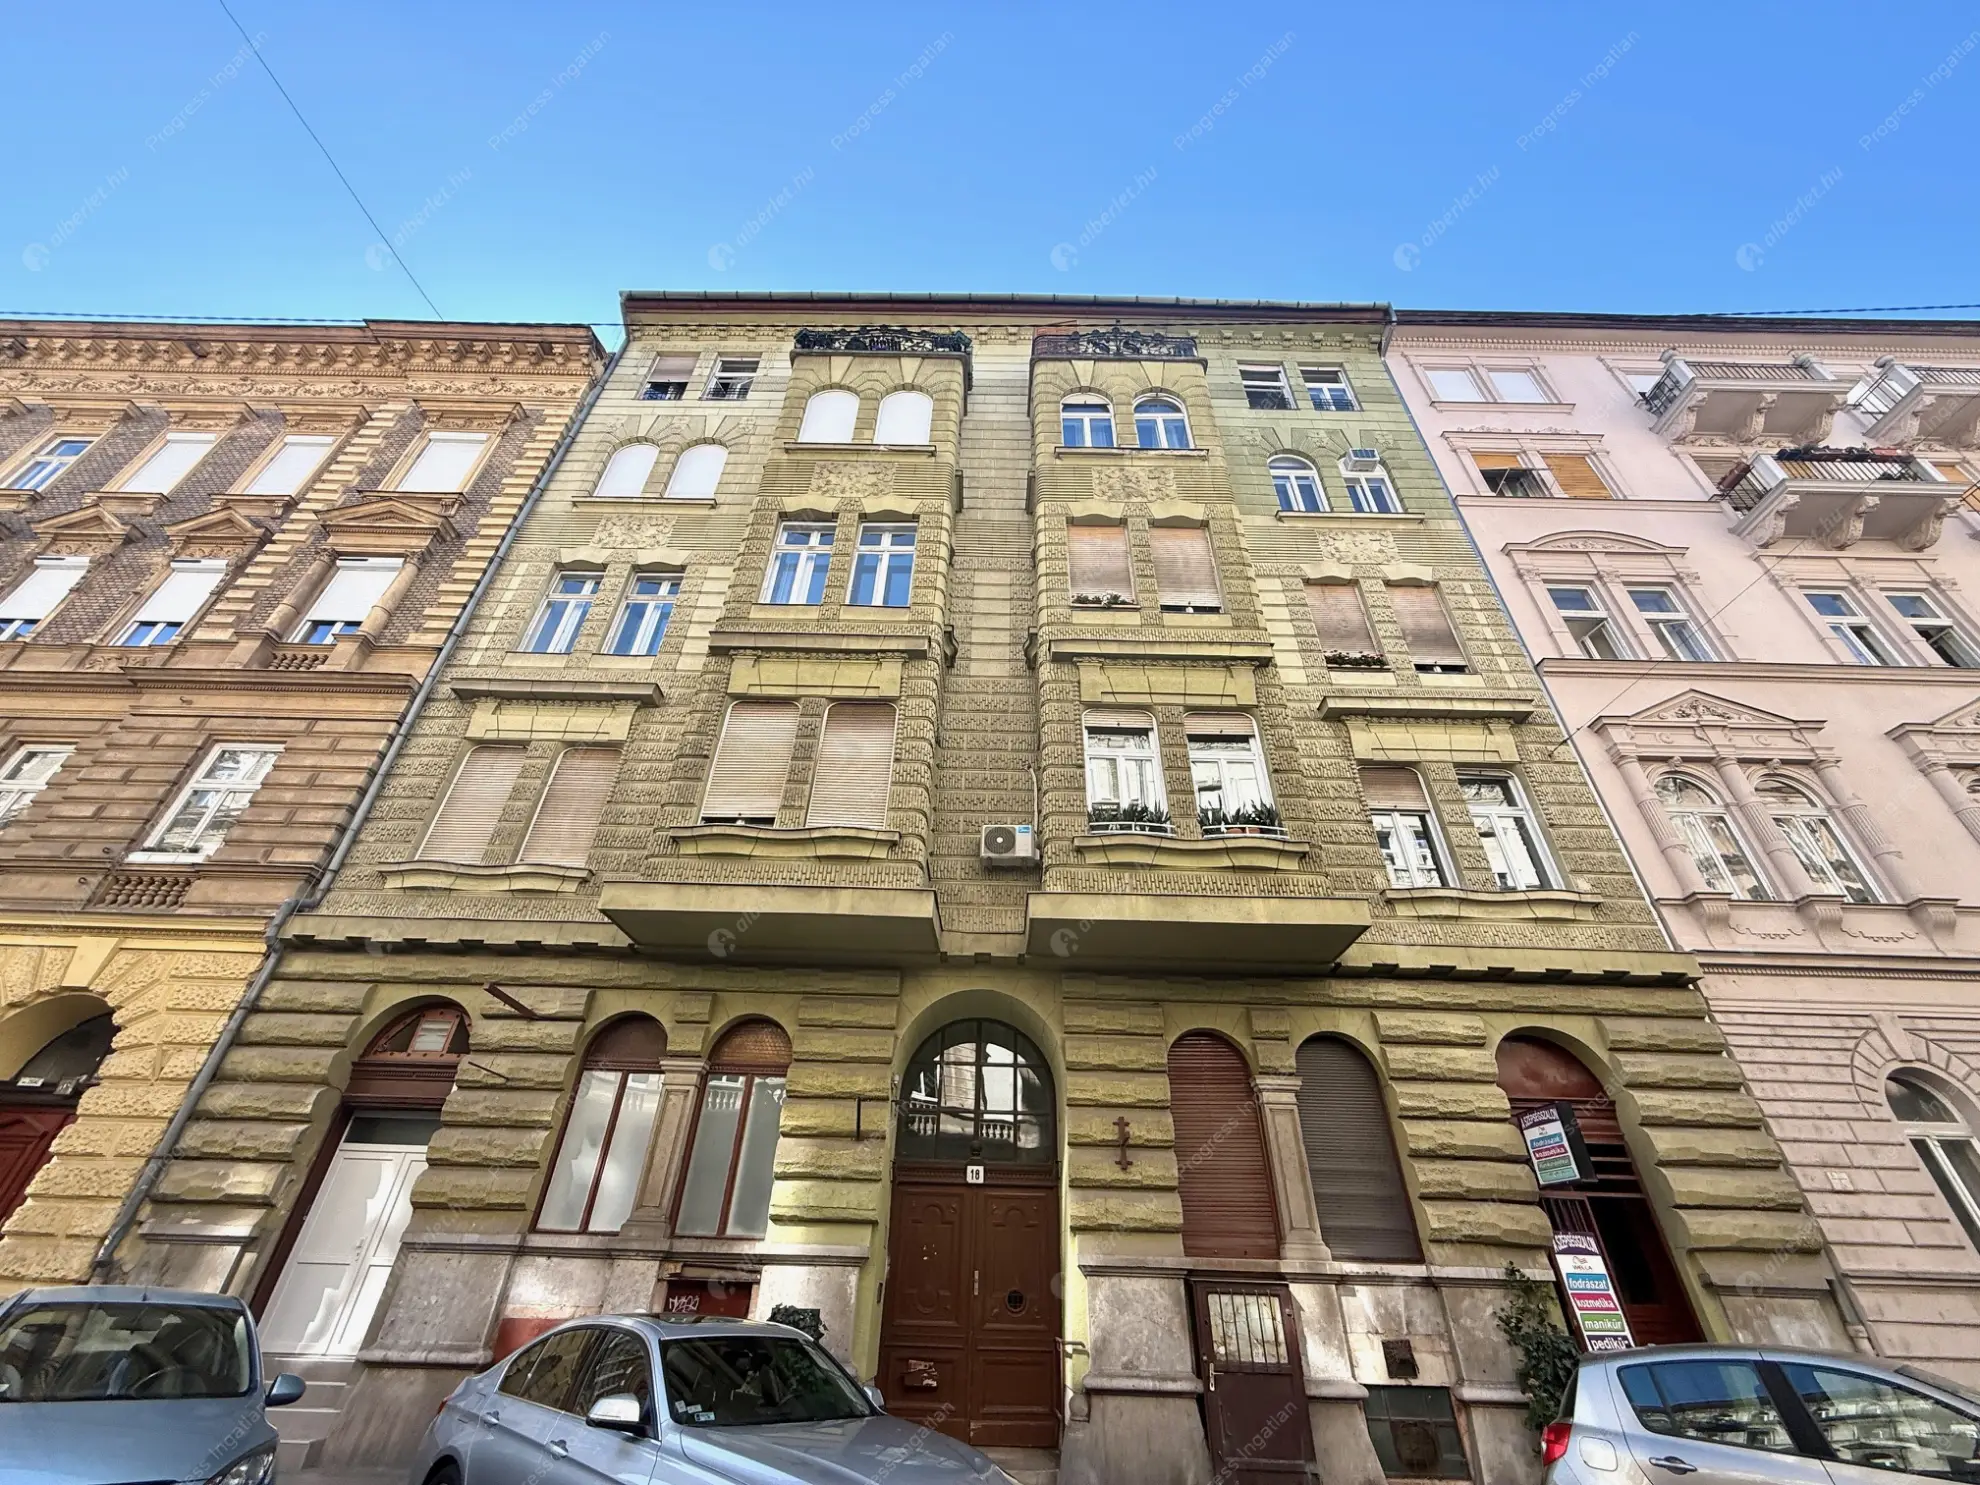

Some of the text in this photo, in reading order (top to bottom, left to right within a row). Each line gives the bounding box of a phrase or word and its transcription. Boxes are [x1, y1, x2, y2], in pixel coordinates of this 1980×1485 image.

[971, 1169, 980, 1180] 18
[1569, 1278, 1608, 1290] fodrászat
[1574, 1298, 1616, 1309] kozmetika
[1584, 1318, 1622, 1329] manikür
[1591, 1337, 1629, 1351] pedikü
